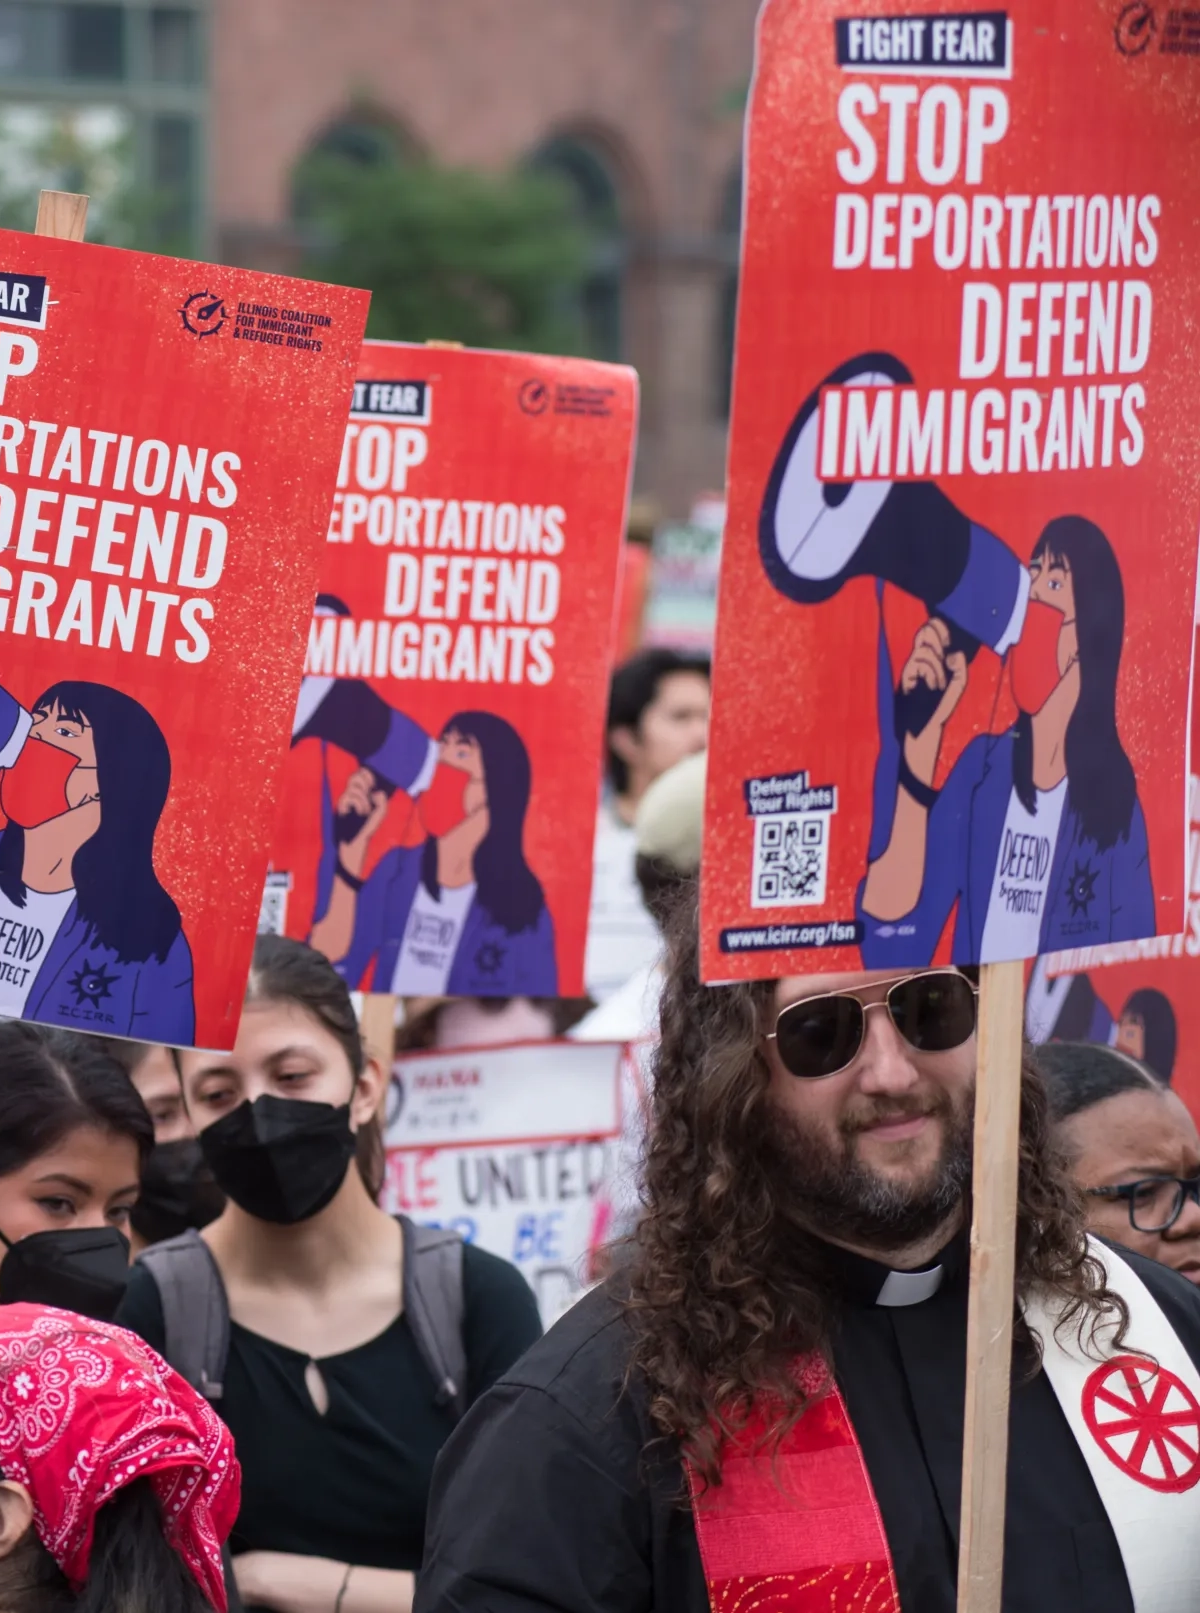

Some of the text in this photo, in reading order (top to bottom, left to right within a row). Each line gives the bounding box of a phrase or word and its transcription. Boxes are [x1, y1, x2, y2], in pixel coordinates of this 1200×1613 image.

[848, 18, 996, 61] FIGHT FEAR
[836, 82, 1010, 185] STOP
[832, 193, 1161, 270] DEPORTATIONS
[235, 314, 313, 337] FOR IMMIGRANT
[237, 302, 332, 328] ILLINOIS COALITION
[959, 280, 1153, 379] DEFEND
[233, 327, 323, 352] & REFUGEE RIGHTS
[369, 384, 420, 414] FEAR
[820, 383, 1146, 478] IMMIGRANTS
[336, 423, 428, 492] TOP
[327, 494, 566, 556] EPORTATIONS
[384, 552, 561, 625] DEFEND
[303, 618, 555, 687] MMIGRANTS
[750, 790, 831, 813] Your Rights
[751, 774, 803, 797] Defend
[1000, 827, 1050, 882] DEFEND
[1005, 887, 1043, 915] PROTECT
[727, 921, 856, 948] www.icirr.org/fsn
[57, 1004, 115, 1025] ICIRR
